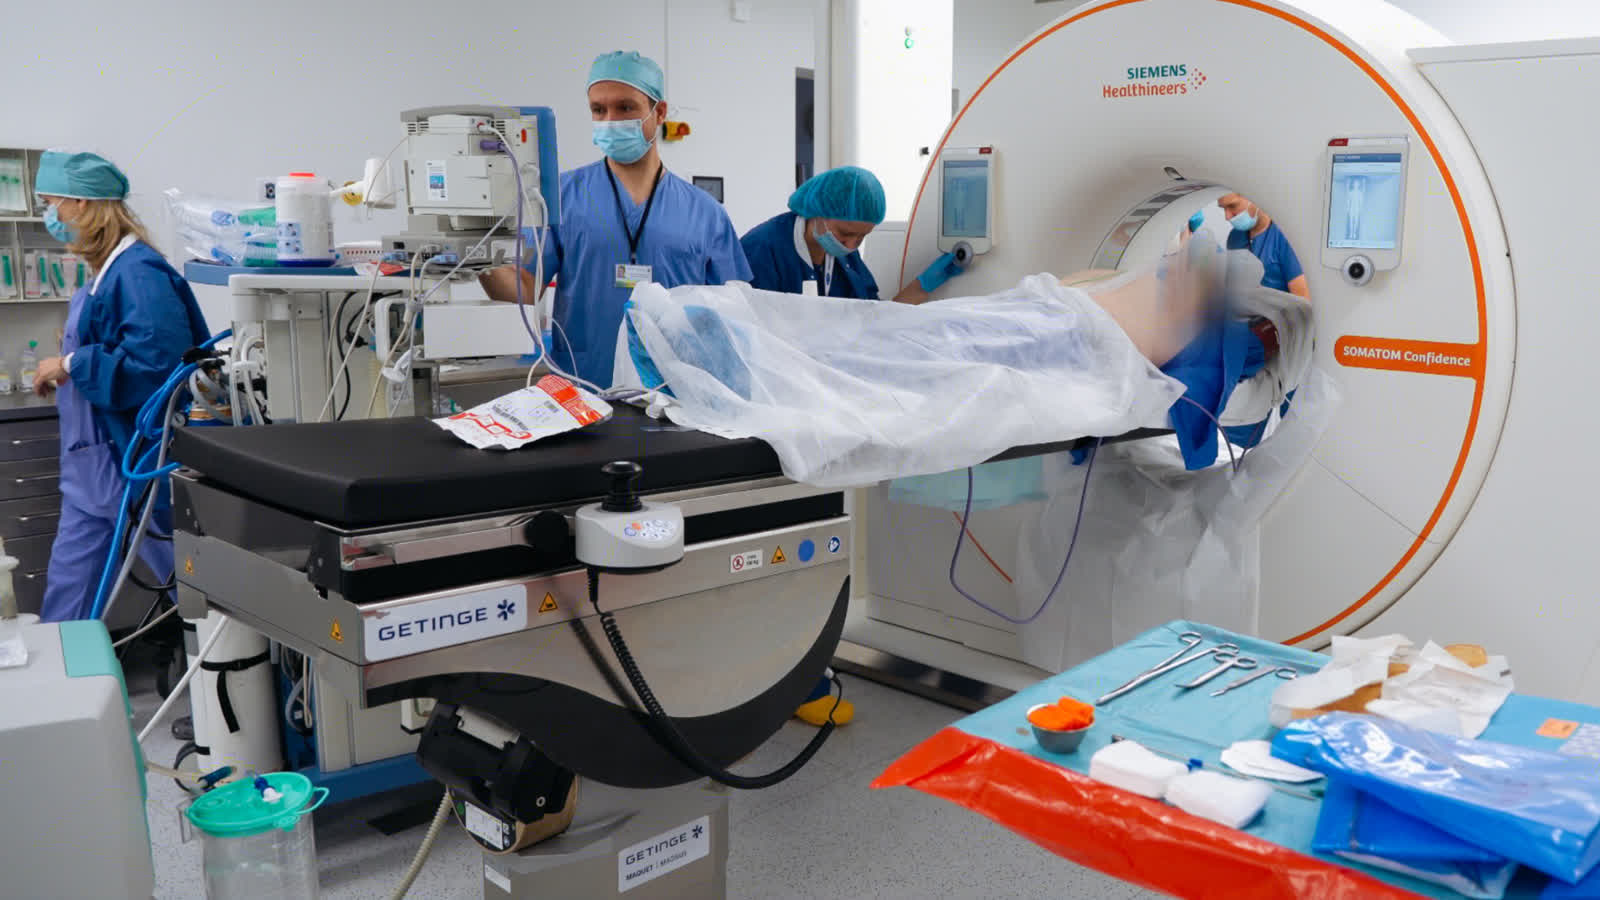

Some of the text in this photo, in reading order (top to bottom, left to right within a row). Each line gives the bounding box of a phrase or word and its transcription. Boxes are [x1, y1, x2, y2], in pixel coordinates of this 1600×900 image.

[1127, 64, 1187, 80] SIEMENS
[1103, 81, 1187, 98] Healthineers
[1343, 345, 1471, 367] SOMATOM Confidence
[378, 607, 488, 641] GETINGE
[625, 832, 687, 865] GETINGE
